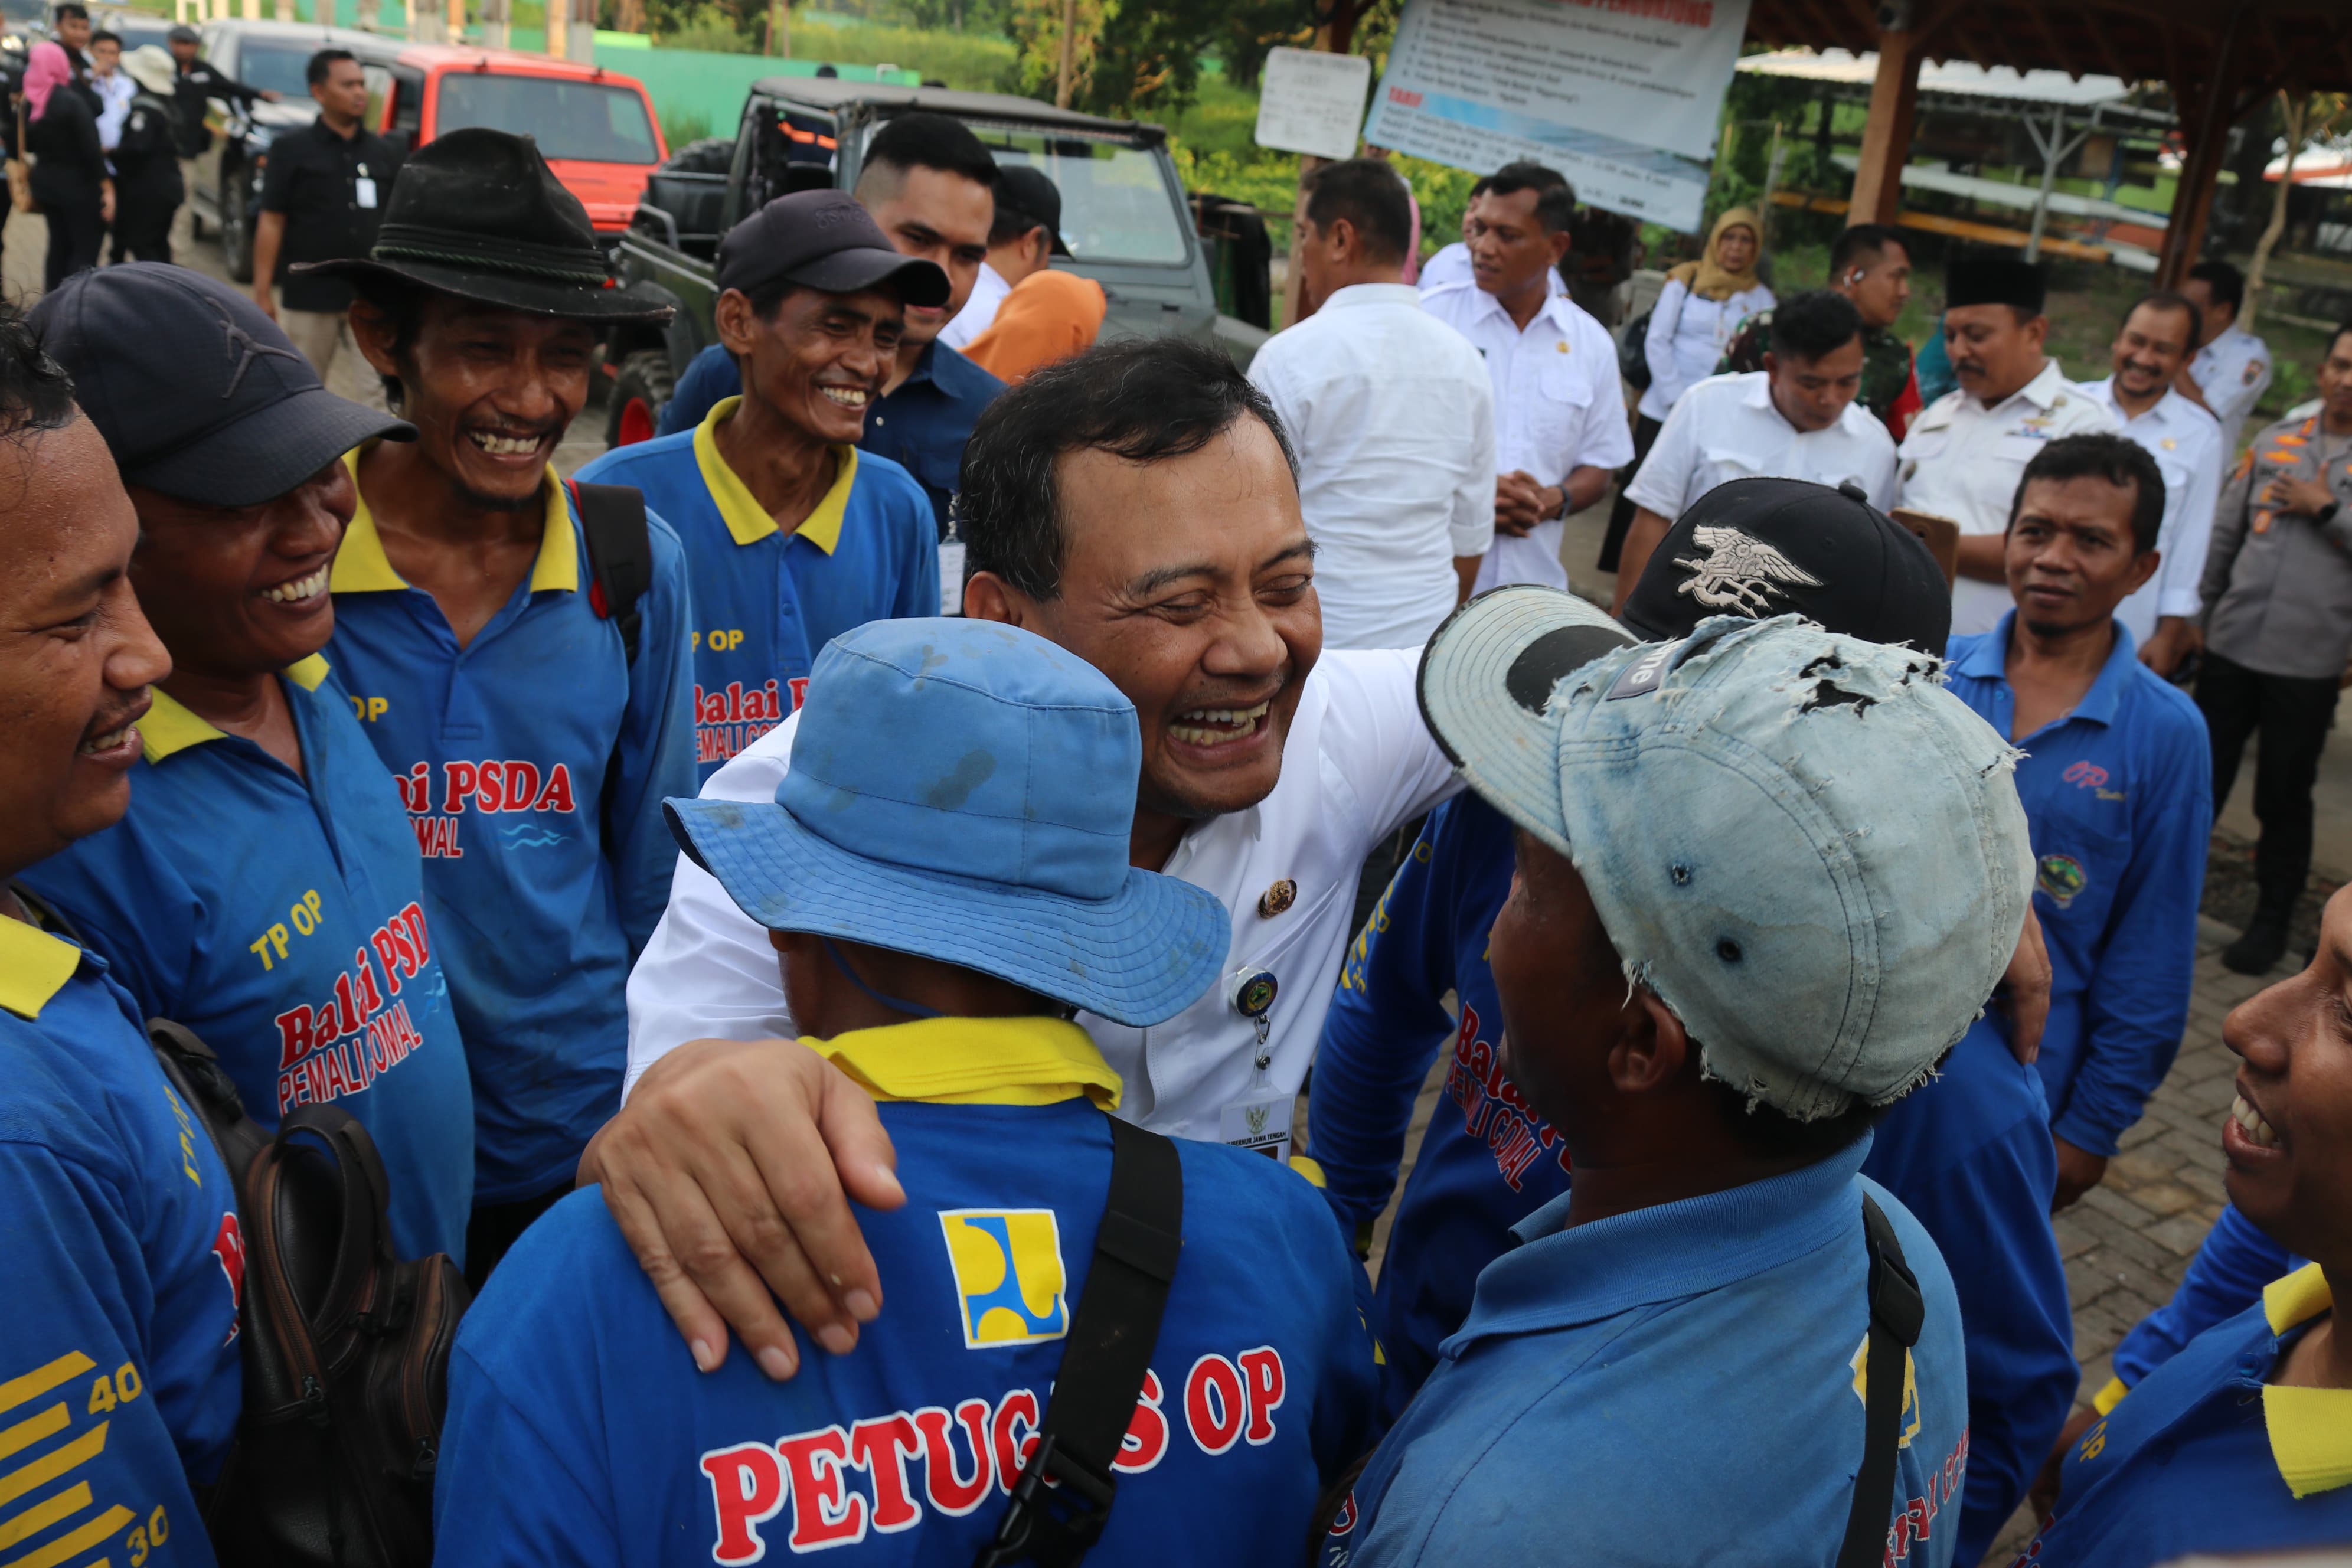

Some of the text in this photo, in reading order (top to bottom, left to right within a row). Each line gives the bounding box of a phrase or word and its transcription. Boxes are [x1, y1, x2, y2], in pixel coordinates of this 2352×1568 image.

[708, 629, 744, 652] OP
[694, 679, 782, 726] Balai
[443, 759, 576, 814] PSDA
[249, 889, 324, 971] TP OP
[274, 946, 384, 1072] Balai
[277, 1037, 371, 1118] PEMALI
[1253, 1134, 1266, 1144] JAWA
[1267, 1131, 1287, 1141] TENGAH
[87, 1361, 143, 1415] 40
[700, 1344, 1286, 1568] PETUGS OP
[126, 1504, 170, 1568] 30
